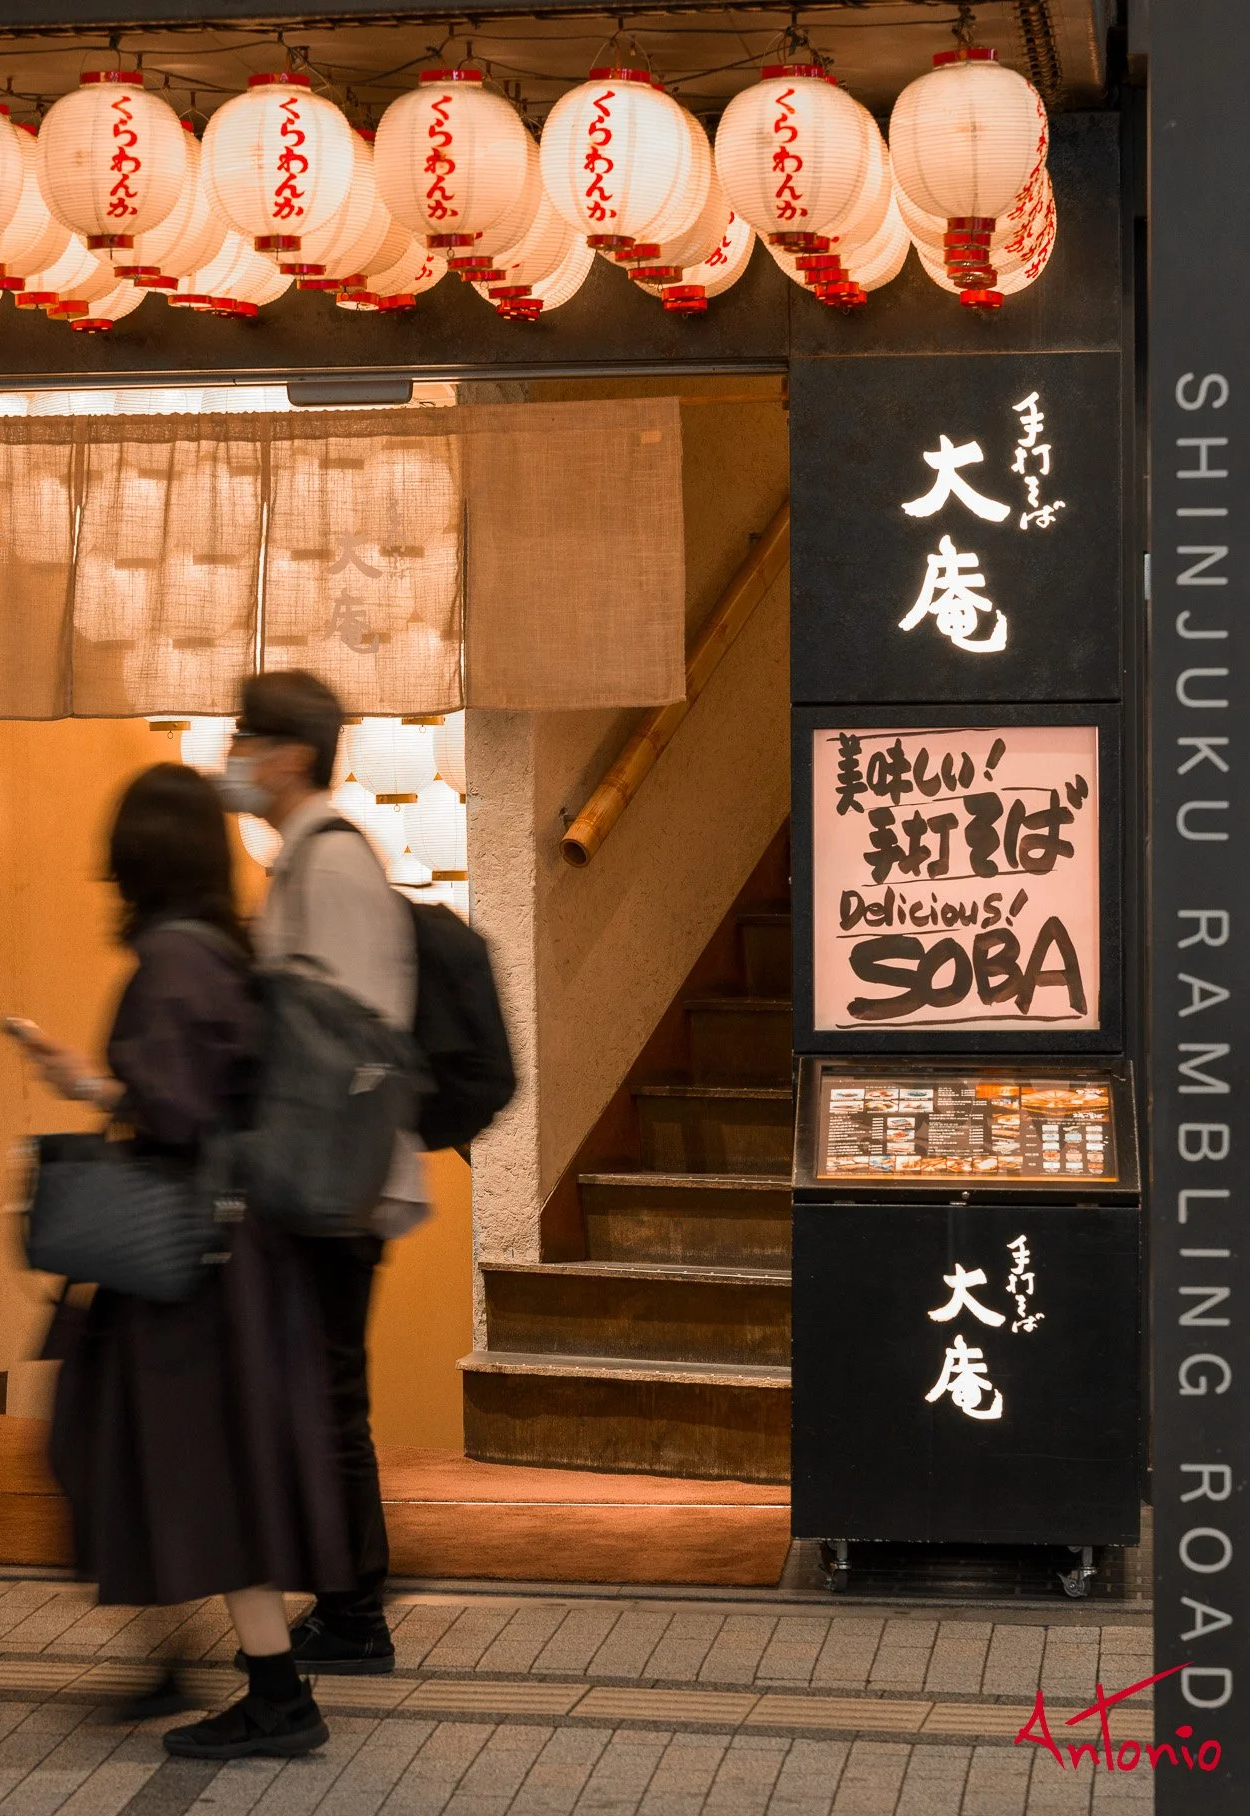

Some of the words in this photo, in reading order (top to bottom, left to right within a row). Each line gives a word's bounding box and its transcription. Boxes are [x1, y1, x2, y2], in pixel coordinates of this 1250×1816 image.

[107, 96, 140, 218] くらわんか
[273, 97, 309, 219] くらわんか
[424, 95, 459, 221] くらわんか
[583, 90, 618, 222] くらわんか
[772, 88, 809, 221] くらわんか
[898, 434, 1011, 653] 大庵
[1175, 372, 1229, 841] SHINJUKU
[863, 774, 1090, 885] 手打そば
[839, 885, 1029, 931] Delicious!
[846, 915, 1088, 1021] SOBA
[1177, 909, 1232, 1395] RAMBLING
[924, 1263, 1006, 1420] 大庵
[1179, 1463, 1232, 1709] ROAD
